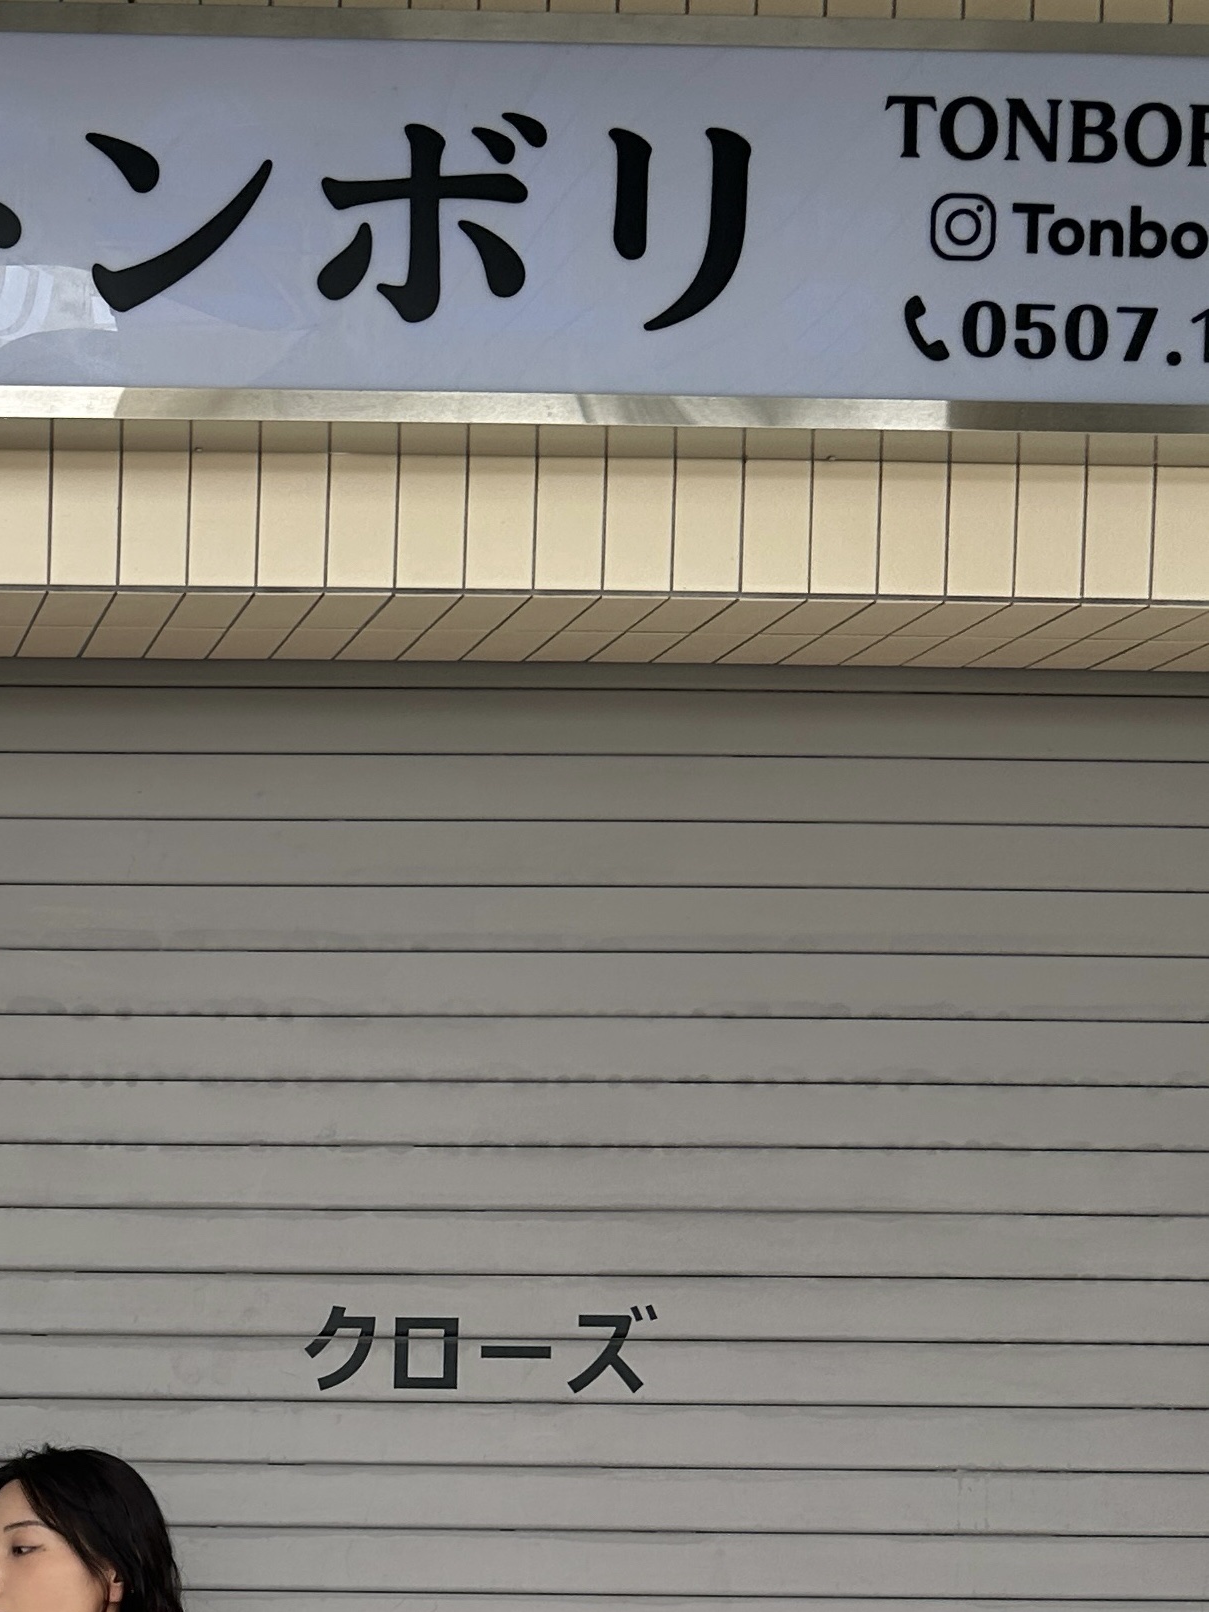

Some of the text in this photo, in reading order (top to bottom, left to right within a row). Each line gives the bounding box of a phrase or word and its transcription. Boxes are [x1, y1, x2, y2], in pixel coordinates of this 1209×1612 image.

[1012, 203, 1209, 260] Tonbo
[304, 1304, 658, 1394] クローズ
